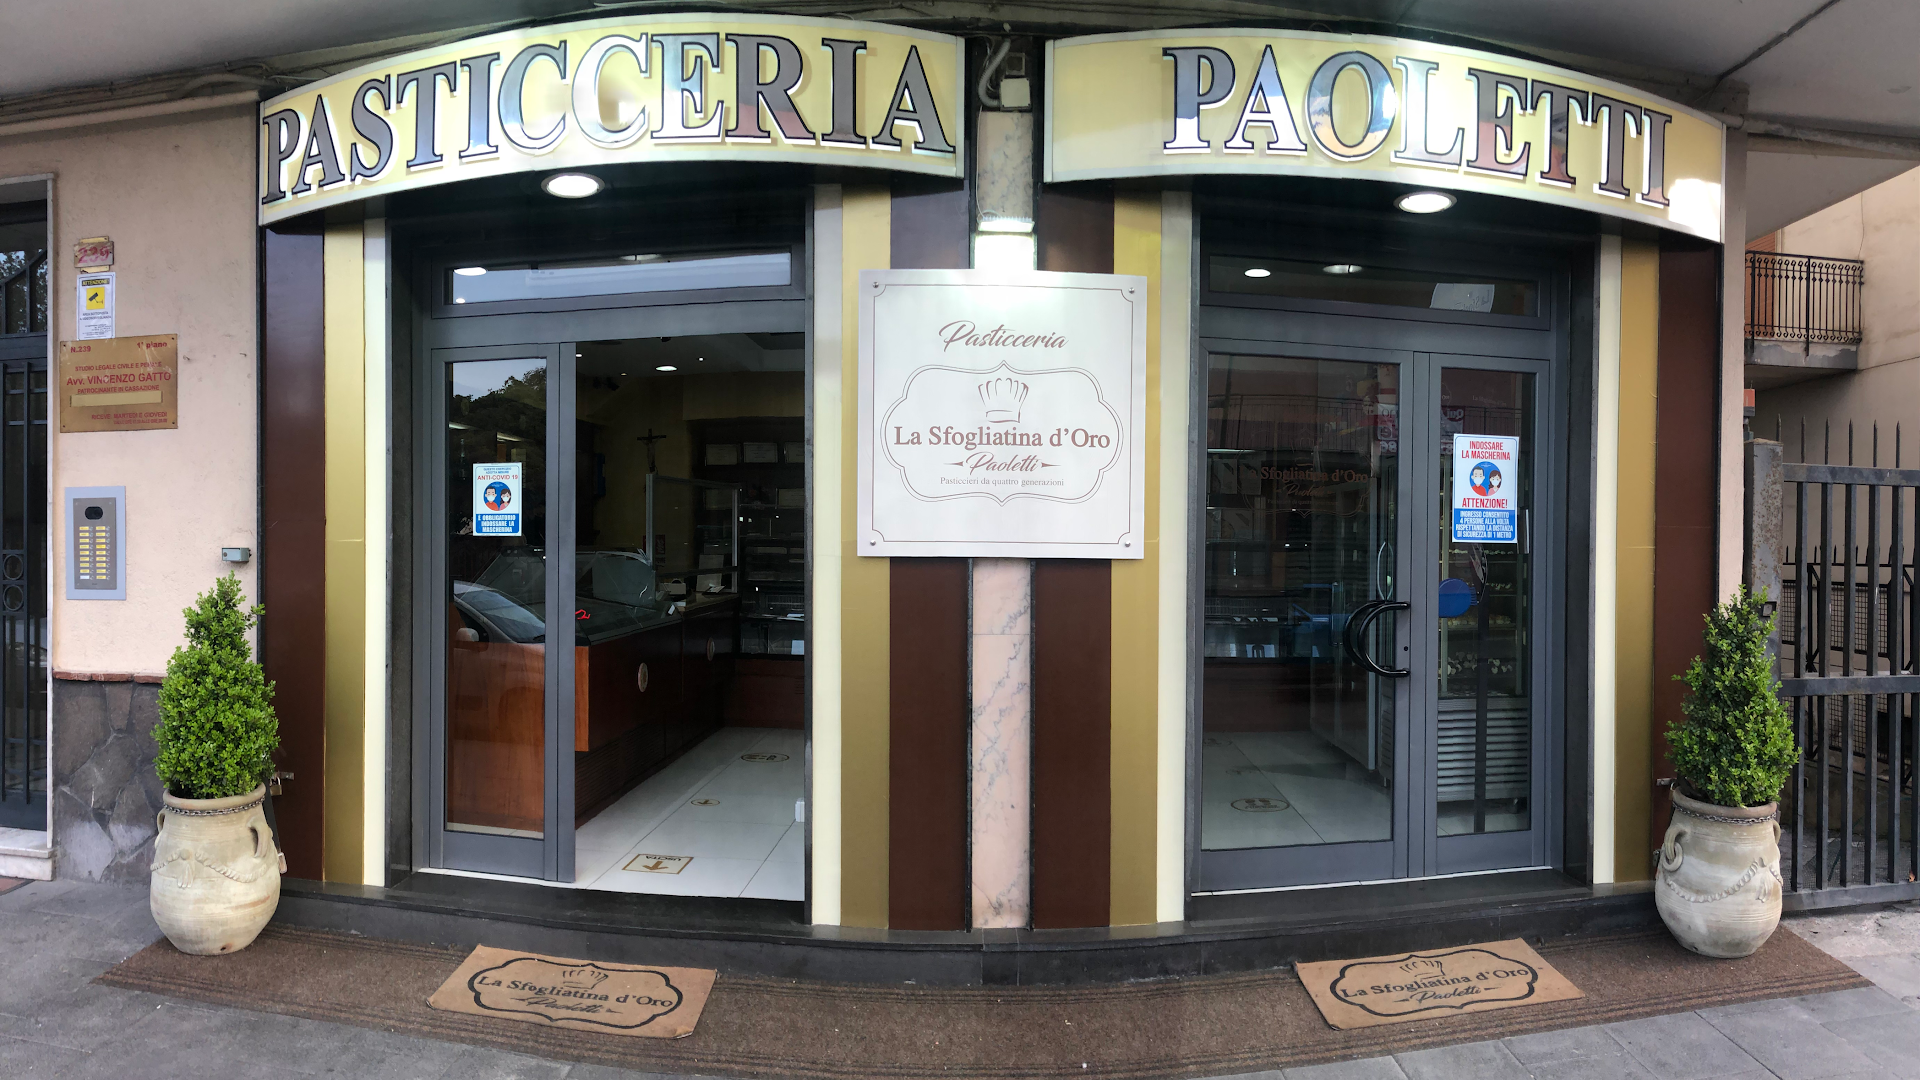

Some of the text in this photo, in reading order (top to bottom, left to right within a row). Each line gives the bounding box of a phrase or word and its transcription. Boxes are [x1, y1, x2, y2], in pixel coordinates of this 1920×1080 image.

[262, 32, 956, 205] PASTICCERIA
[1162, 45, 1673, 207] PAOLETTI
[938, 320, 1069, 352] Pasticceria
[66, 372, 171, 386] Avv. VINCENZO GATTO
[894, 425, 1111, 450] La Sfogliatina d'Oro
[1469, 440, 1504, 451] INDOSSARE
[965, 451, 1044, 475] Paoletti
[1462, 450, 1510, 460] LA MASCHERINA
[940, 476, 1064, 488] Pasticcieri da quattro generazioni
[1331, 468, 1368, 484] d'Oro
[1462, 498, 1508, 508] ATTENZIONE!
[477, 976, 674, 1008] La Sfogliatina d'Oro
[1340, 967, 1530, 998] La Sfogliatina d'Oro
